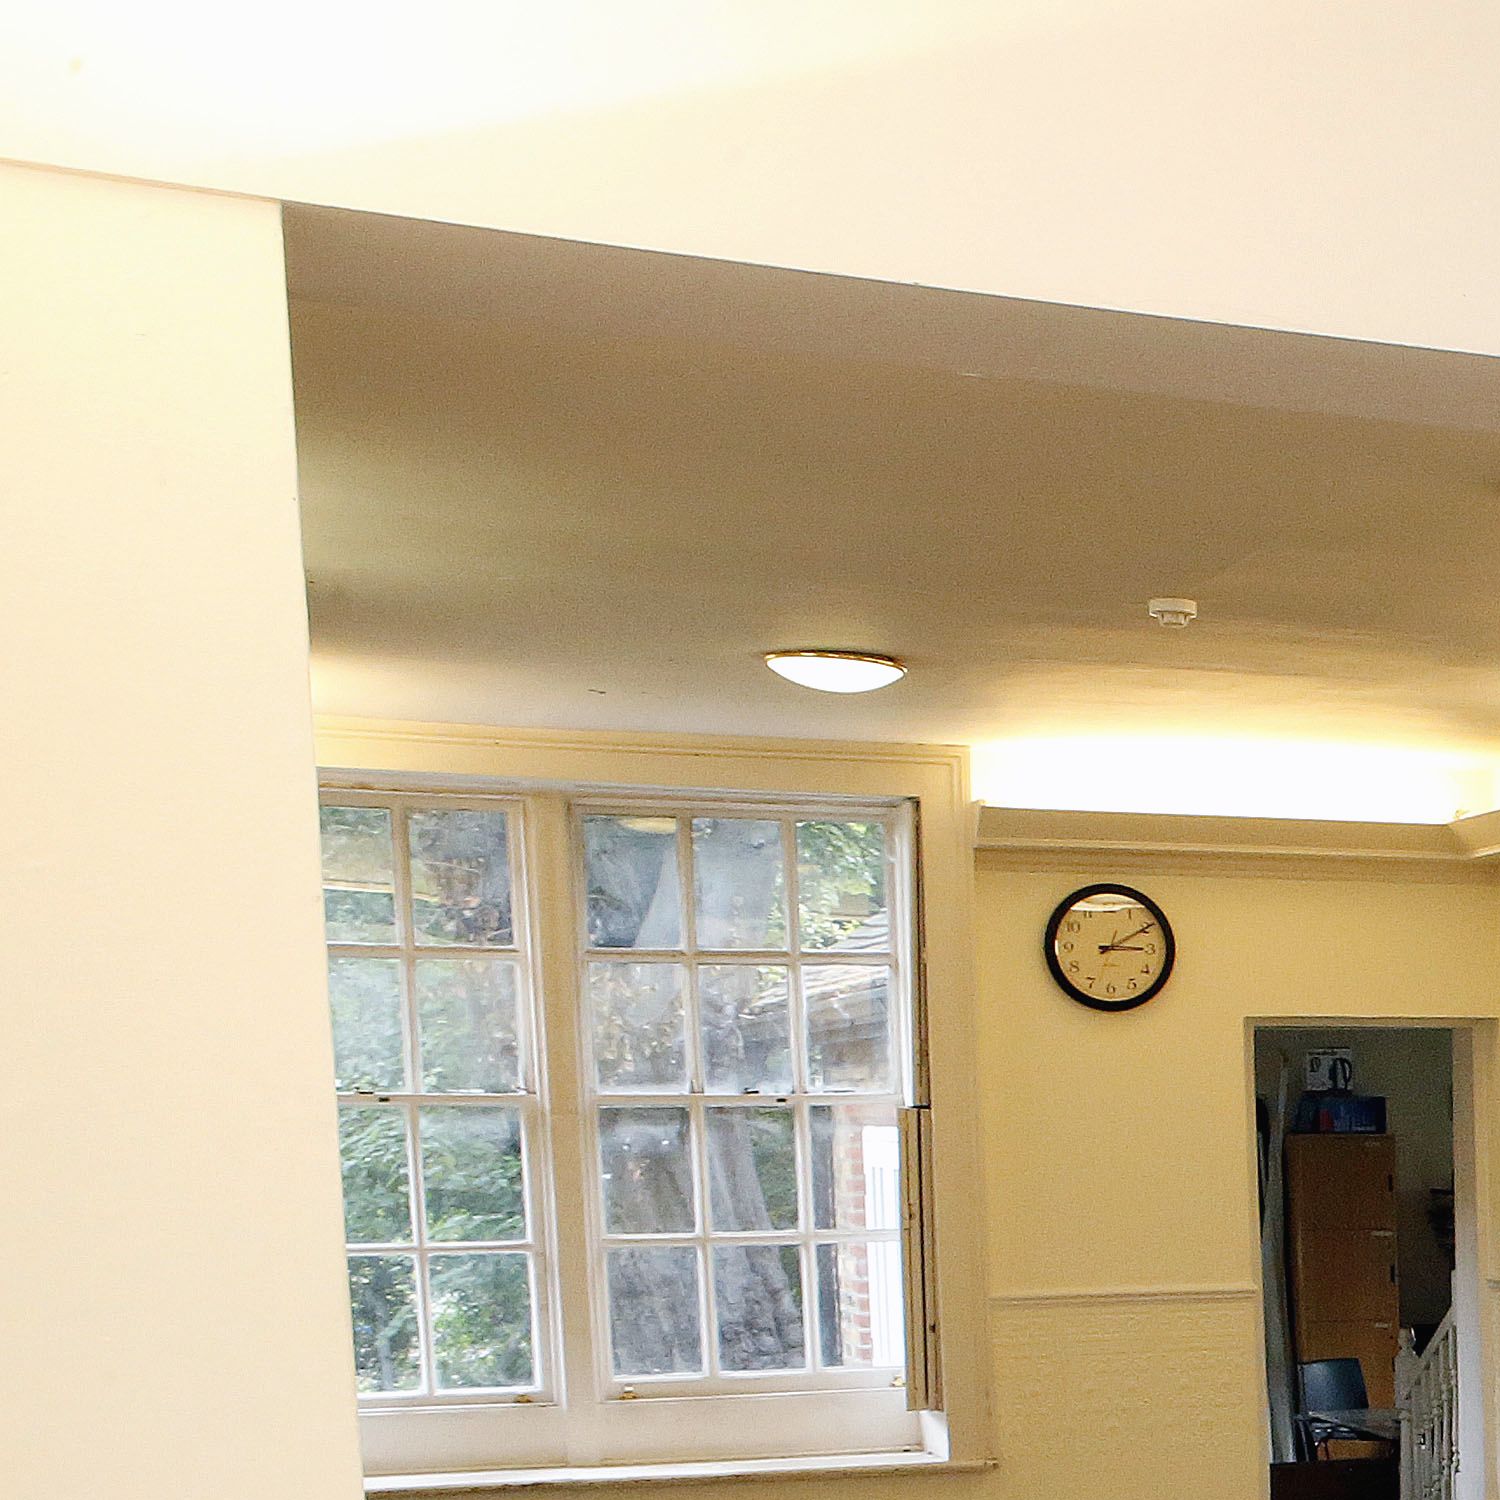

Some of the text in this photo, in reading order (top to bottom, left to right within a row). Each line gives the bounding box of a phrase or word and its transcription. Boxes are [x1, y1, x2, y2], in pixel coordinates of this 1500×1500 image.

[1065, 921, 1081, 934] 10
[1063, 941, 1074, 953] 9
[1145, 943, 1156, 955] 3
[1068, 961, 1080, 973] 8
[1141, 963, 1150, 975] 4
[1086, 976, 1096, 989] 7
[1106, 982, 1117, 994] 6
[1126, 978, 1137, 990] 5
